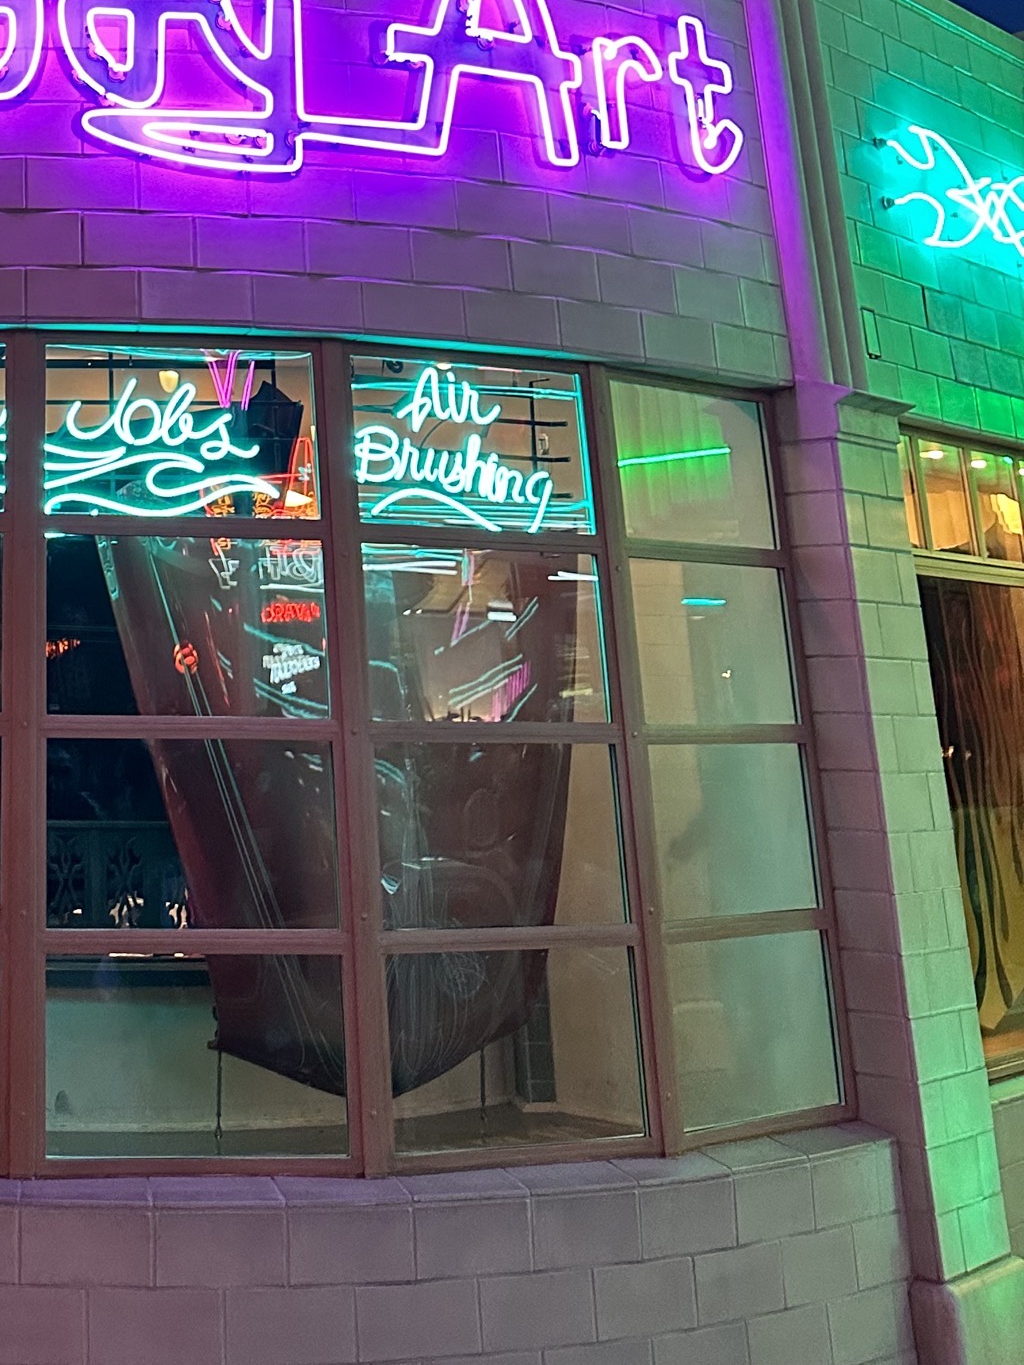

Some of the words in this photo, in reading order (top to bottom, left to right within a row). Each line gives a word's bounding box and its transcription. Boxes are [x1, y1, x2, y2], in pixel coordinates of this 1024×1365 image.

[66, 377, 260, 461] Jobs
[396, 366, 502, 433] Air
[353, 426, 553, 535] Brushing
